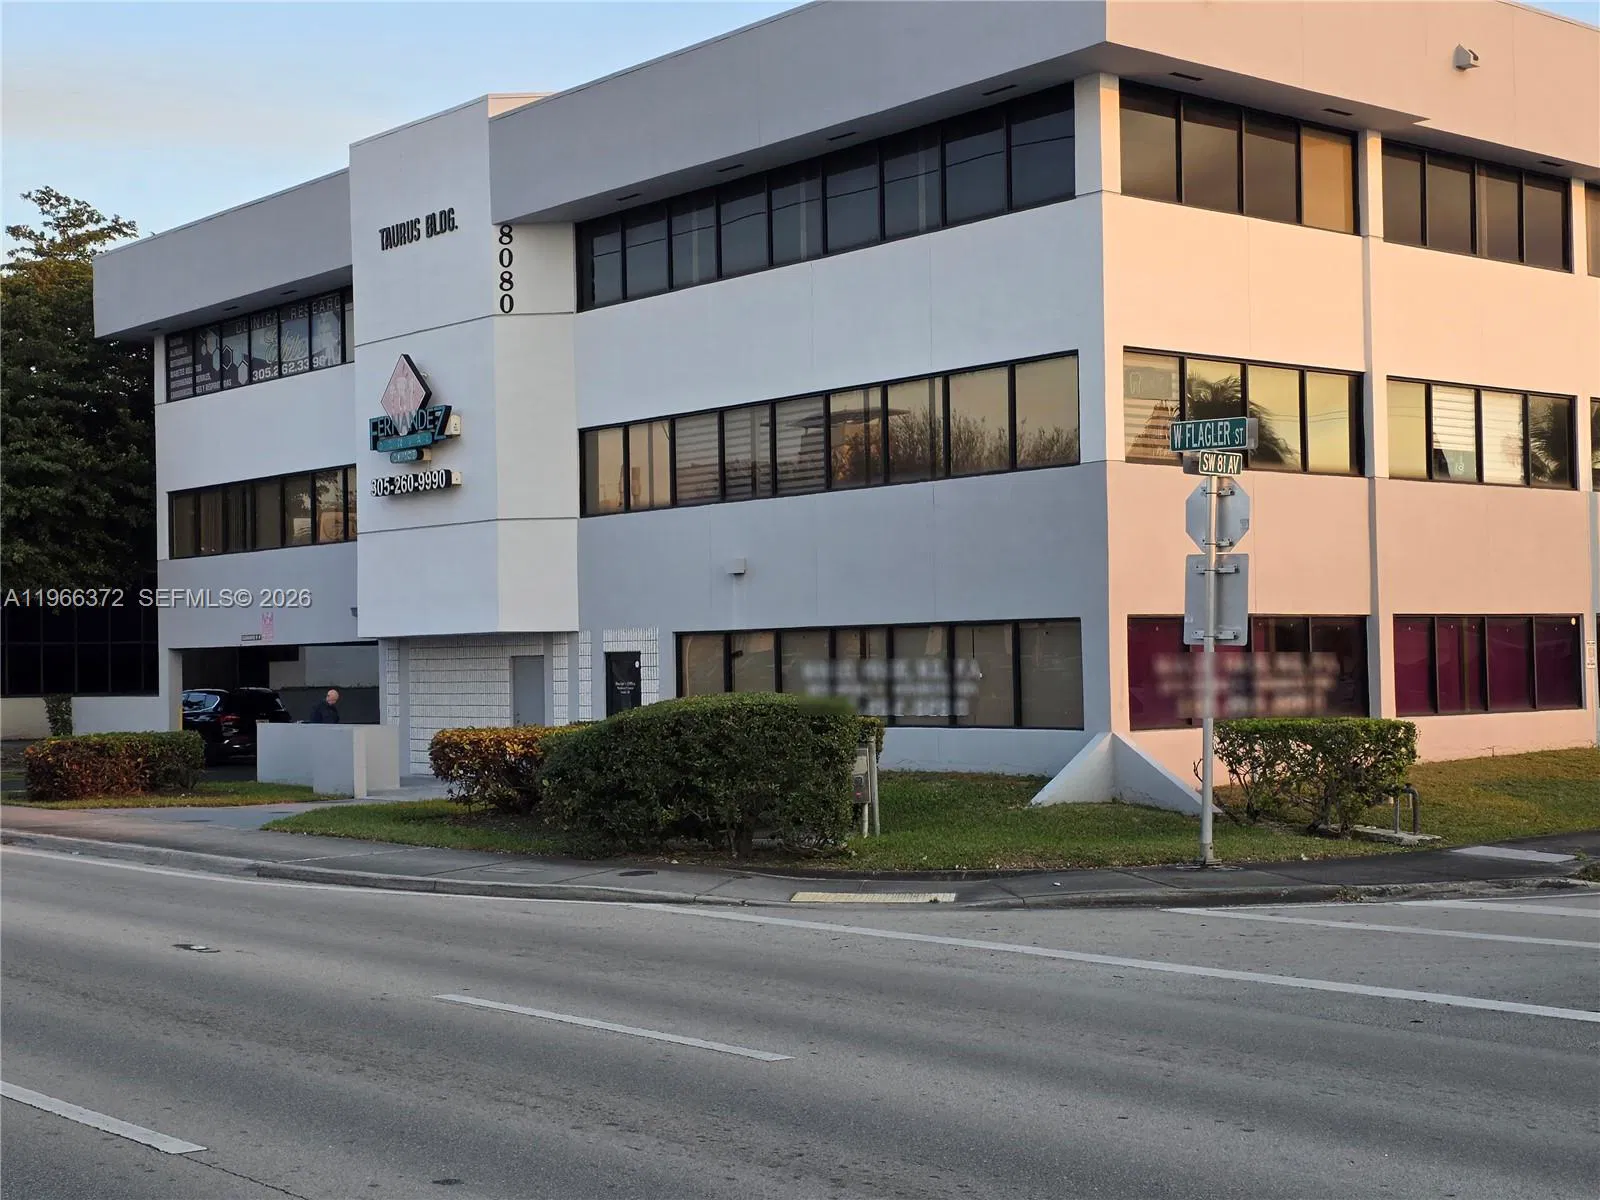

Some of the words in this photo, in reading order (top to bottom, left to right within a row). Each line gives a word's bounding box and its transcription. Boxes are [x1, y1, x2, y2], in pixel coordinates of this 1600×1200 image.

[379, 217, 421, 251] TAURUS
[425, 207, 458, 238] BLDG.
[499, 224, 514, 314] 8080
[369, 405, 447, 450] FERNANDEZ
[1173, 424, 1182, 449] W
[1185, 421, 1231, 448] FLAGLER
[1234, 427, 1244, 445] ST
[1202, 453, 1216, 471] SW
[1217, 454, 1226, 473] 81
[1228, 456, 1240, 474] AV
[371, 469, 446, 497] 305-260-9990
